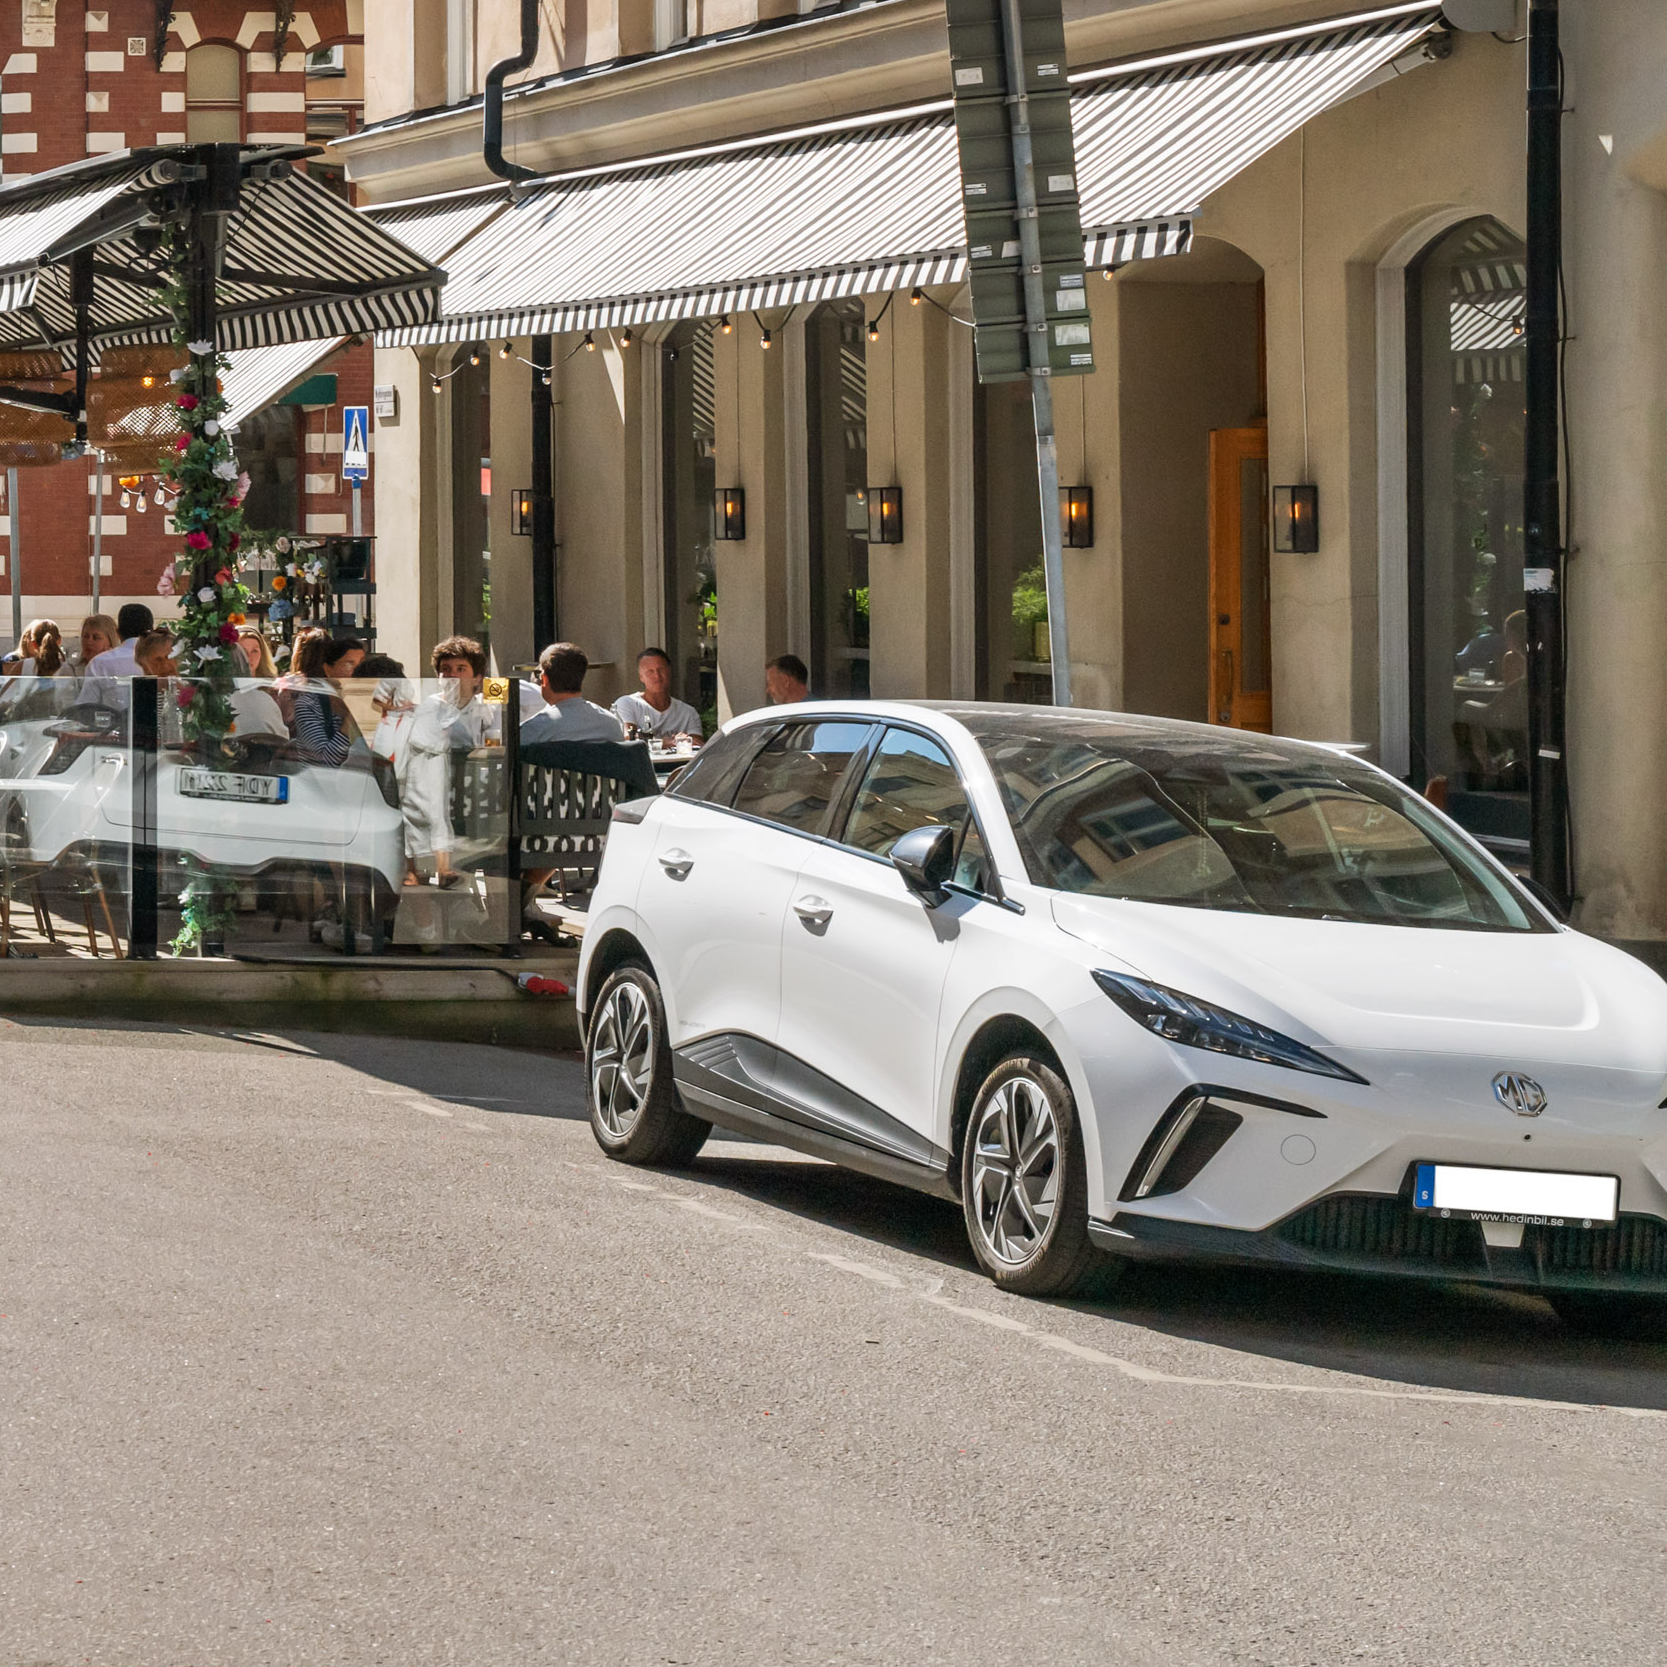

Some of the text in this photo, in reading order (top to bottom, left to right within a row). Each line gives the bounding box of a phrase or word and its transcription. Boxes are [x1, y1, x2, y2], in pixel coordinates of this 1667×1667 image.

[1494, 1072, 1547, 1116] MG
[1420, 1190, 1429, 1200] S
[1470, 1211, 1565, 1227] www.hedinbil.se
